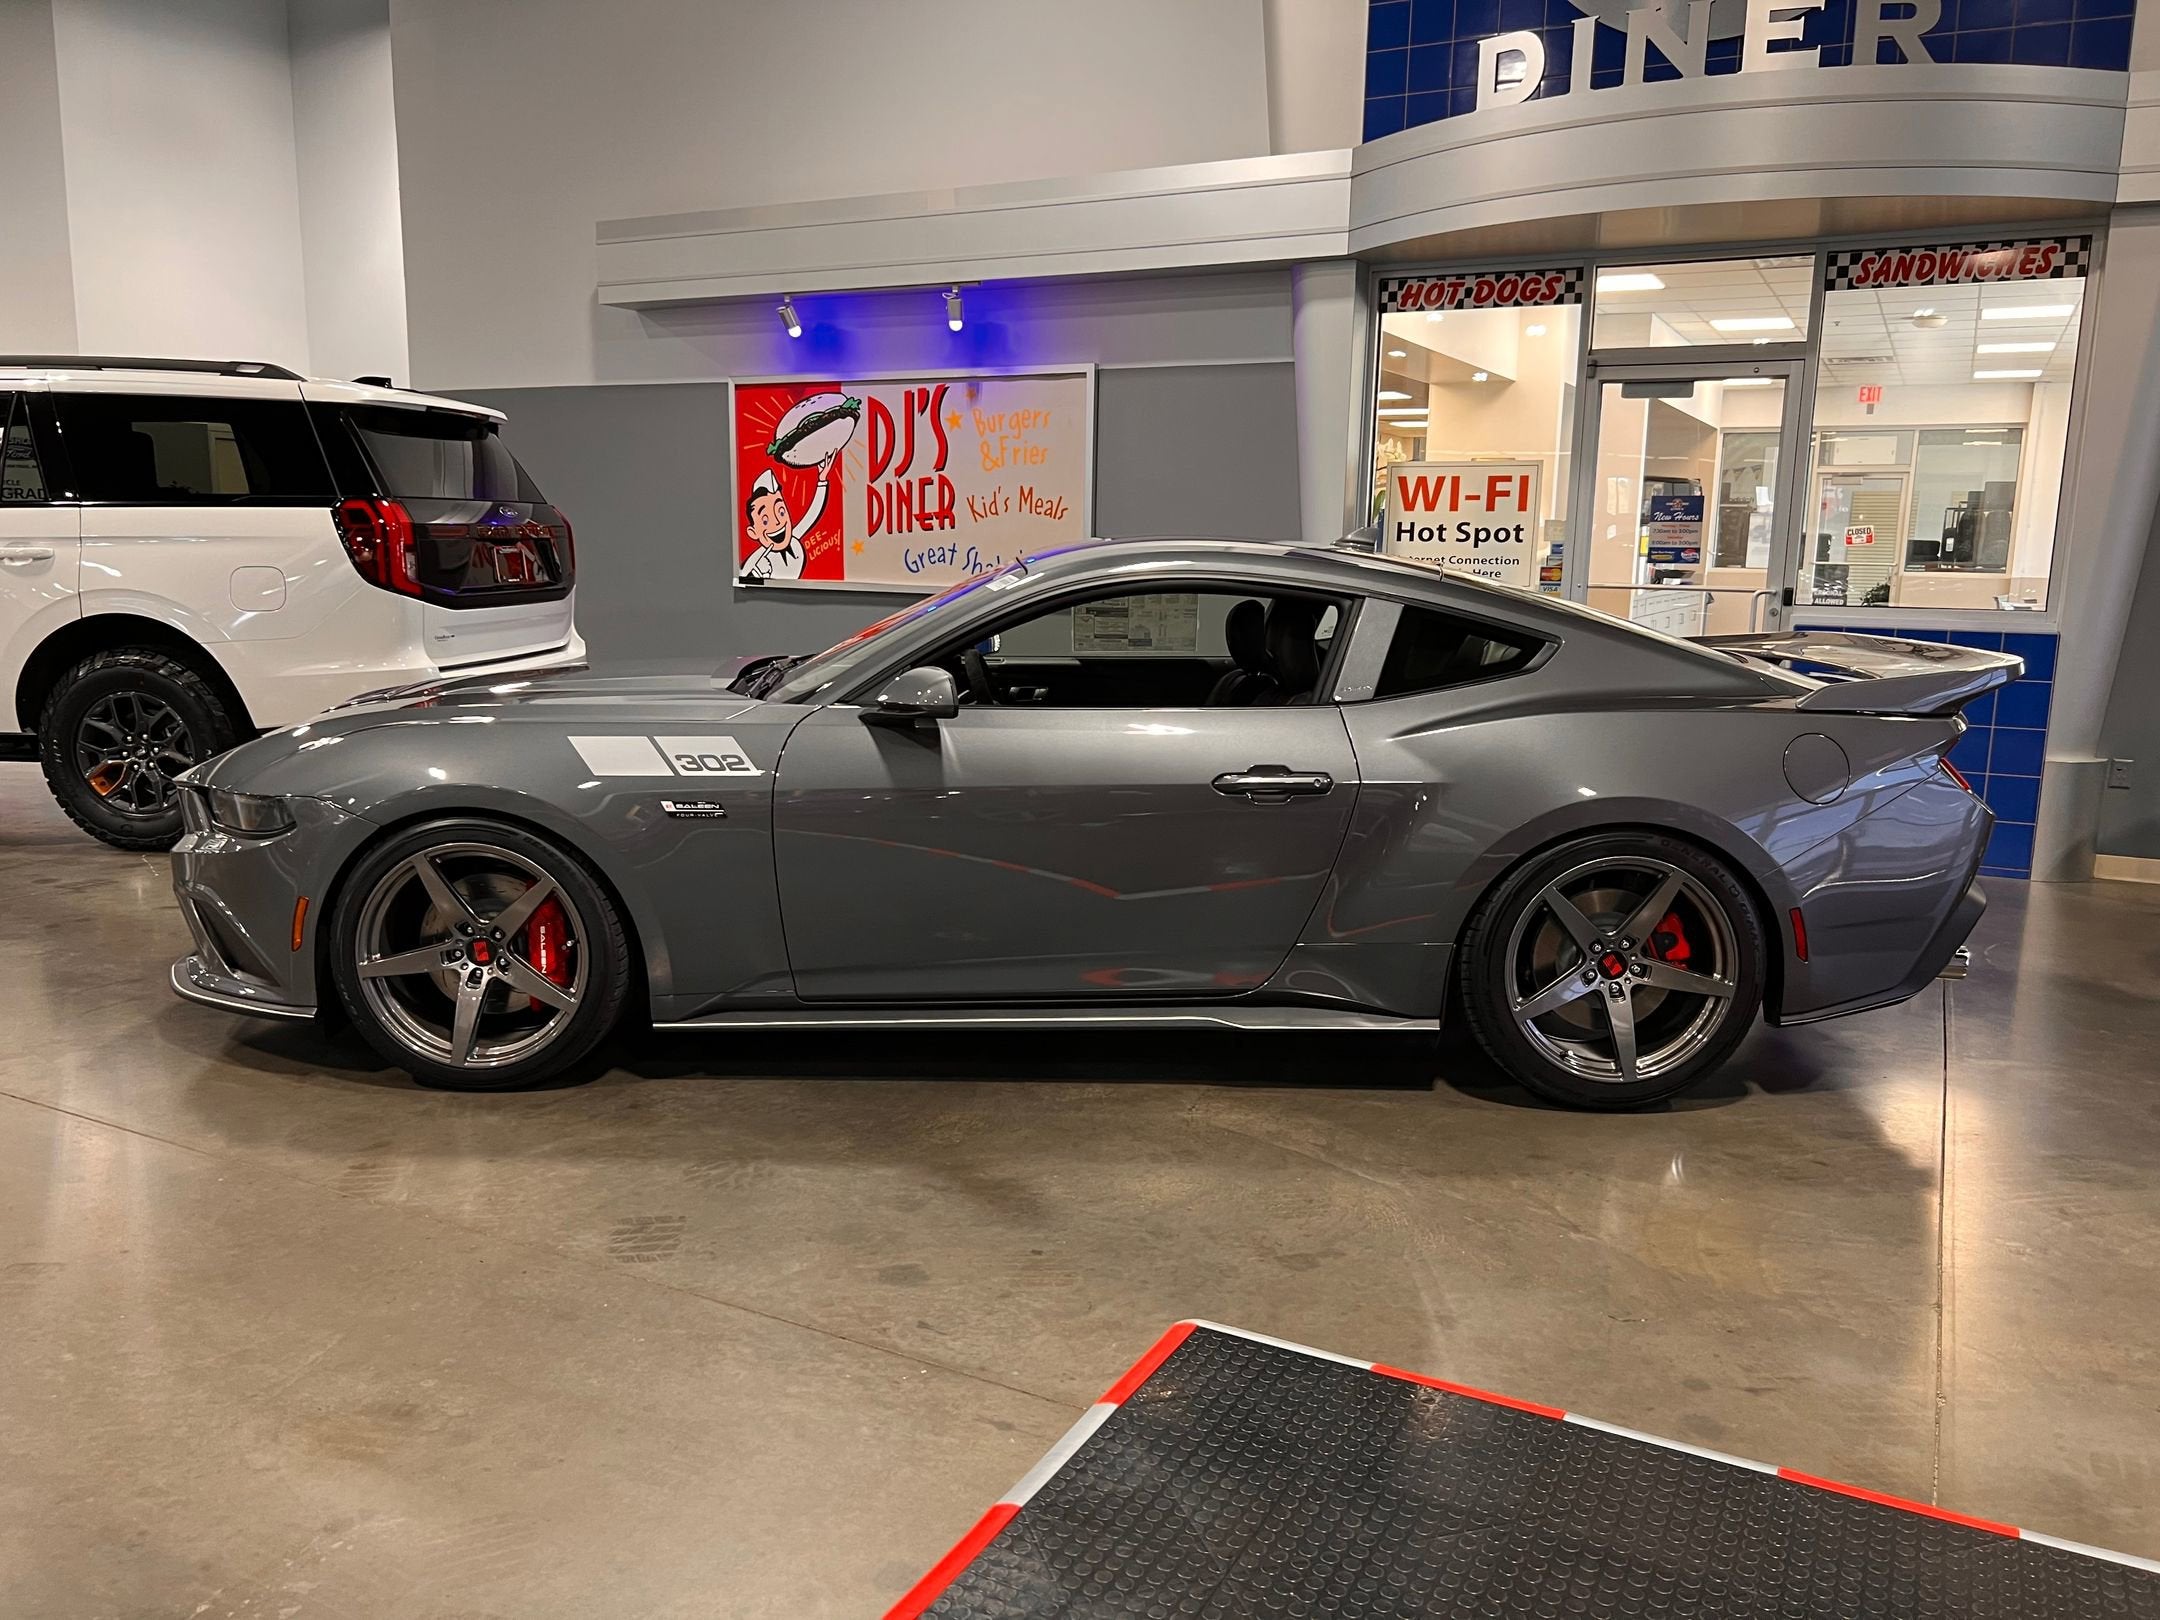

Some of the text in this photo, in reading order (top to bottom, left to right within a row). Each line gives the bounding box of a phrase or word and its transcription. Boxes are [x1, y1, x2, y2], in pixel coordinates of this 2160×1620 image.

[1476, 0, 1942, 111] DINER
[1855, 245, 2059, 285] SANDWICHES
[1400, 275, 1563, 308] HOT DOGS
[1859, 386, 1883, 402] EXIT
[867, 383, 950, 484] DJ'S
[972, 407, 1052, 441] Burgers
[867, 472, 956, 538] DINER
[966, 486, 1069, 523] Kid's Meals
[1397, 474, 1530, 513] WI-FI
[1653, 511, 1700, 521] New Hours
[1847, 527, 1872, 536] CLOSED
[804, 530, 828, 549] DEE-
[809, 528, 841, 561] LICIOUS!
[1396, 521, 1525, 549] Hot Spot
[904, 542, 958, 574] Great
[1448, 555, 1520, 566] Connection
[674, 754, 752, 772] 302
